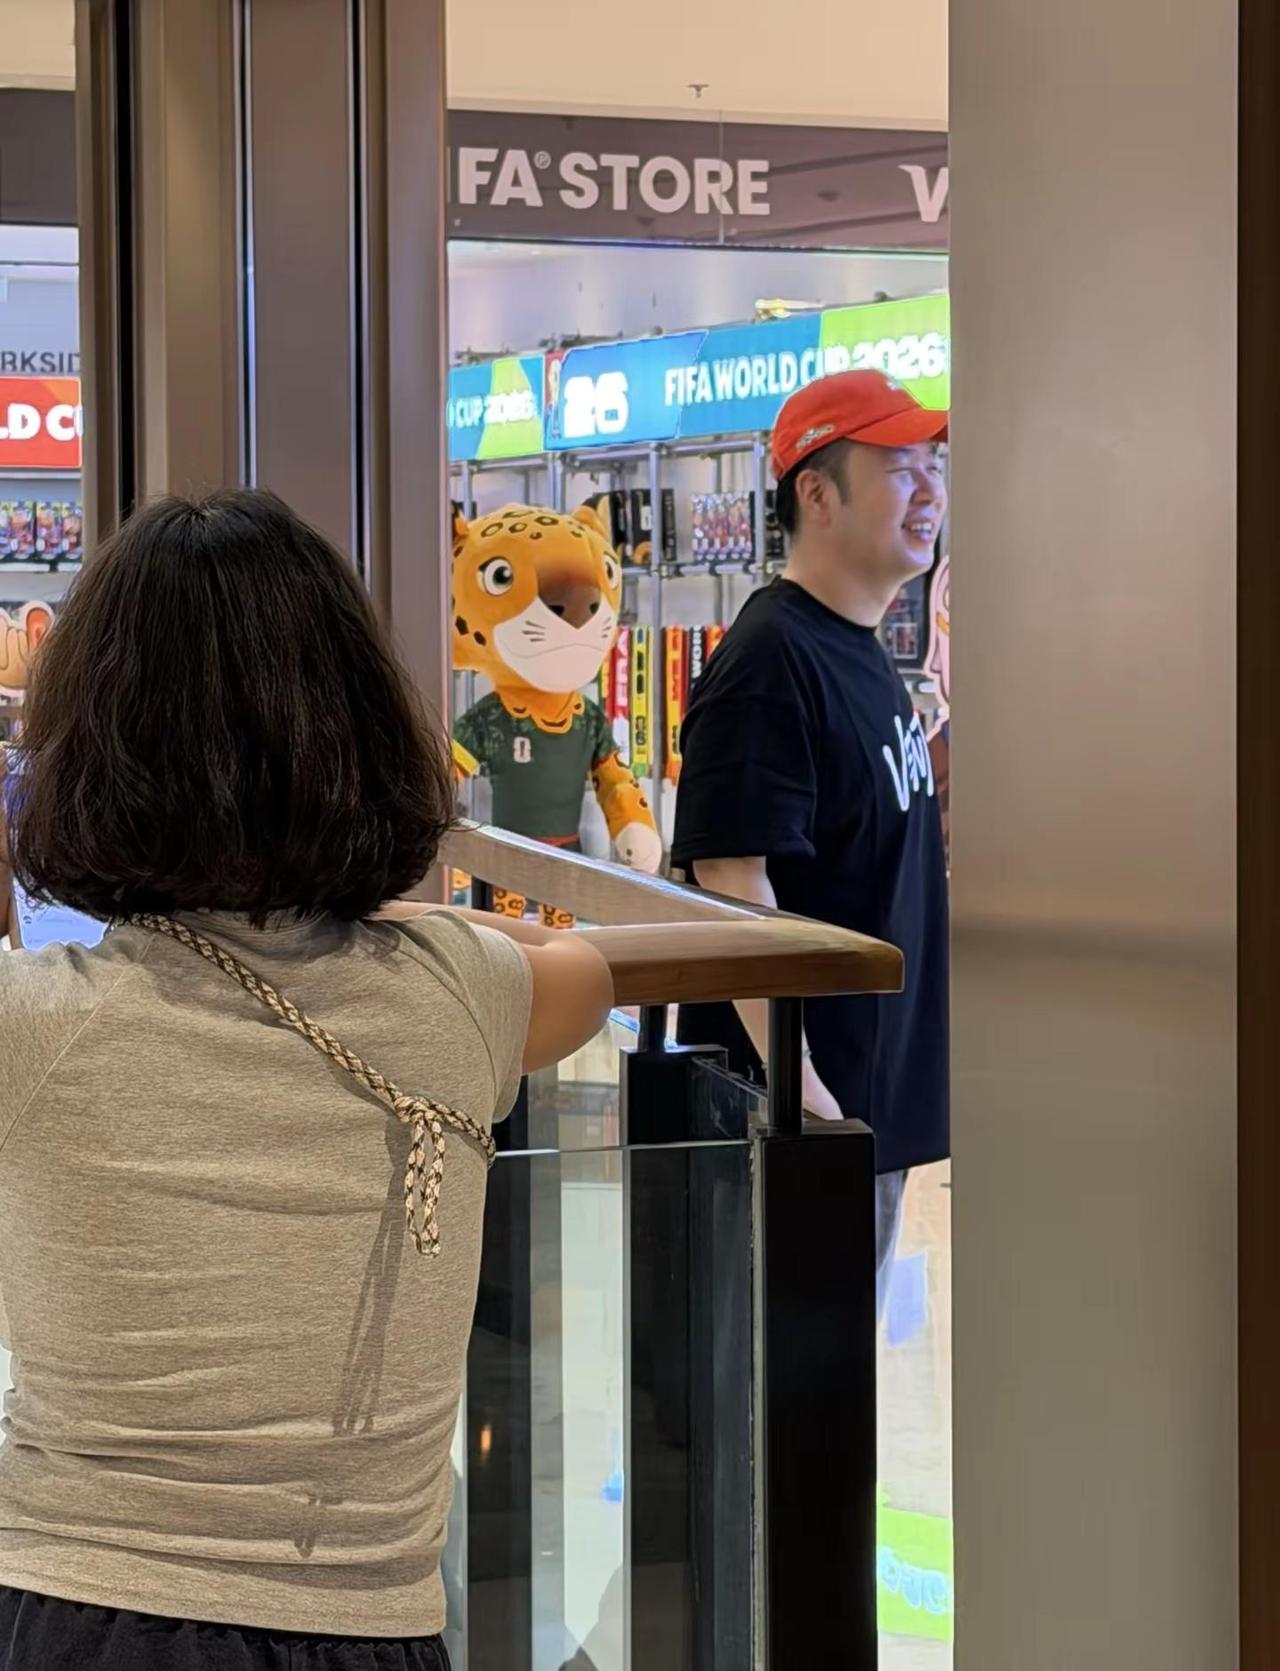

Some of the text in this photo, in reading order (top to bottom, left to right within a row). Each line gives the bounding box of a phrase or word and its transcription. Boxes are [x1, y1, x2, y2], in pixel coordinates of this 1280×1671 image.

[558, 150, 771, 216] STORE
[664, 361, 712, 407] FIFA
[712, 350, 798, 401] WORLD
